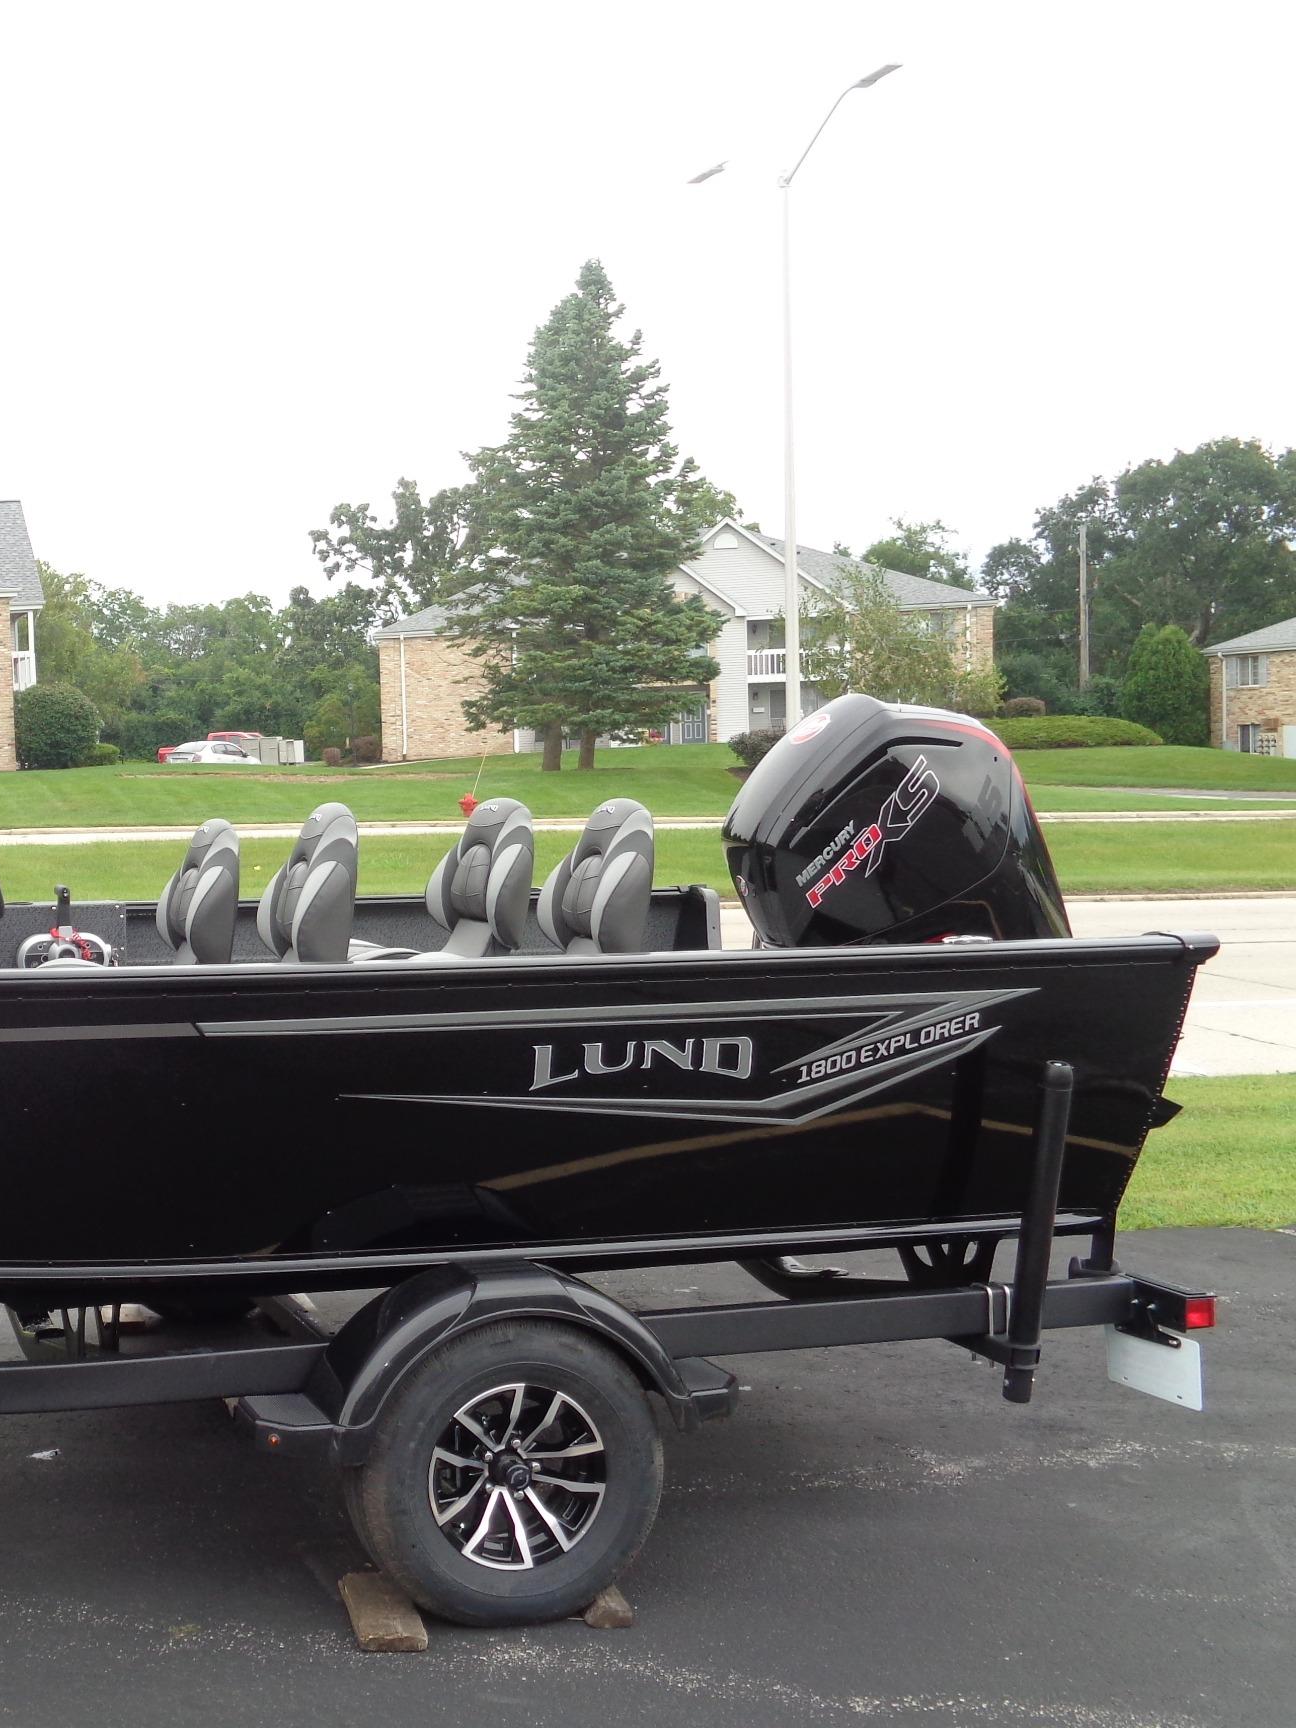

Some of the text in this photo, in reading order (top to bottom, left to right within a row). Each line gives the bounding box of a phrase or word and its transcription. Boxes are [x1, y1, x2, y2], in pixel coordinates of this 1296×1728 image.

[795, 820, 856, 888] MERCURY
[528, 1036, 753, 1092] LUND
[796, 1012, 981, 1084] 1800 EXPLORER
